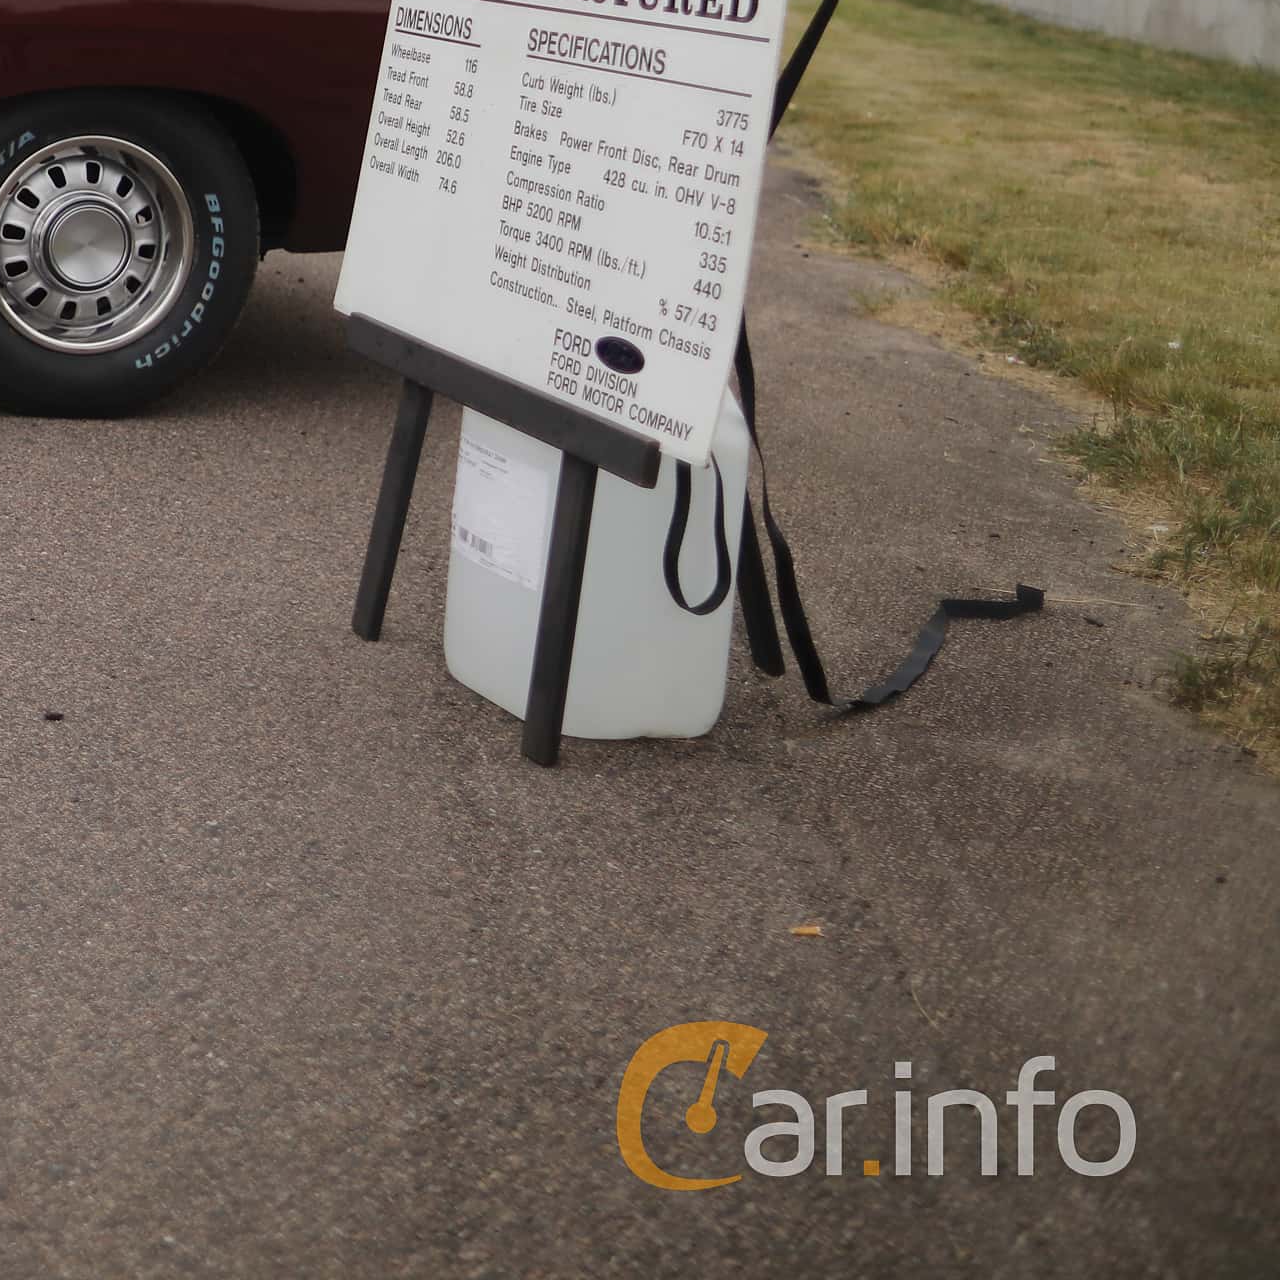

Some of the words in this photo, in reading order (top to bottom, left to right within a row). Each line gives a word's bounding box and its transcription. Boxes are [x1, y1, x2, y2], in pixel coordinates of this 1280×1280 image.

[395, 6, 473, 40] DIMENSIONS
[527, 28, 666, 75] SPECIFICATIONS
[387, 66, 406, 83] Tread
[408, 71, 429, 89] Front
[453, 81, 474, 99] 58.8
[391, 42, 431, 64] Wheelbase
[465, 58, 478, 74] 116
[378, 111, 403, 130] Overall
[405, 118, 431, 138] Height
[445, 129, 465, 147] 52.6
[383, 88, 403, 106] Tread
[404, 93, 423, 111] Rear
[449, 106, 470, 123] 58.5
[519, 95, 537, 113] Tire
[540, 100, 563, 119] Size
[682, 130, 708, 150] F70
[713, 136, 723, 153] X
[730, 140, 744, 157] 14
[521, 72, 545, 91] Curb
[549, 77, 584, 100] Weight
[588, 83, 617, 106] (lbs.)
[715, 109, 749, 131] 3775
[369, 155, 396, 174] Overall
[397, 163, 420, 183] Width
[438, 176, 458, 195] 74.6
[374, 132, 398, 151] Overall
[400, 140, 429, 161] Length
[435, 150, 462, 169] 206.0
[510, 145, 543, 166] Engine
[548, 154, 572, 175] Type
[603, 169, 627, 189] 428
[631, 179, 648, 194] cu.
[654, 181, 668, 199] in.
[675, 186, 705, 207] OHV
[711, 193, 736, 215] V-8
[513, 120, 548, 142] Brakes
[559, 131, 593, 152] Power
[597, 140, 627, 161] Front
[632, 147, 662, 172] Disc,
[668, 156, 699, 177] Rear
[704, 164, 740, 188] Drum
[502, 195, 523, 213] BHP
[526, 201, 553, 223] 5200
[557, 210, 582, 232] RPM
[699, 251, 727, 274] 335
[506, 170, 572, 202] Compression
[576, 189, 605, 212] Ratio
[694, 221, 732, 246] 10.5:1
[135, 193, 225, 369] BFGoodrich
[494, 243, 527, 269] Weight
[530, 256, 591, 291] Distribution
[659, 298, 668, 316] %
[674, 304, 718, 332] 57/43
[499, 219, 531, 244] Torque
[535, 231, 564, 253] 3400
[567, 240, 592, 262] RPM
[693, 278, 722, 300] 440
[553, 328, 592, 357] FORD
[566, 297, 597, 325] Steel,
[602, 309, 653, 341] Platform
[658, 328, 711, 360] Chassis
[550, 351, 581, 376] FORD
[586, 365, 638, 399] DIVISION
[546, 371, 578, 396] FORD
[582, 384, 624, 415] MOTOR
[628, 403, 693, 441] COMPANY
